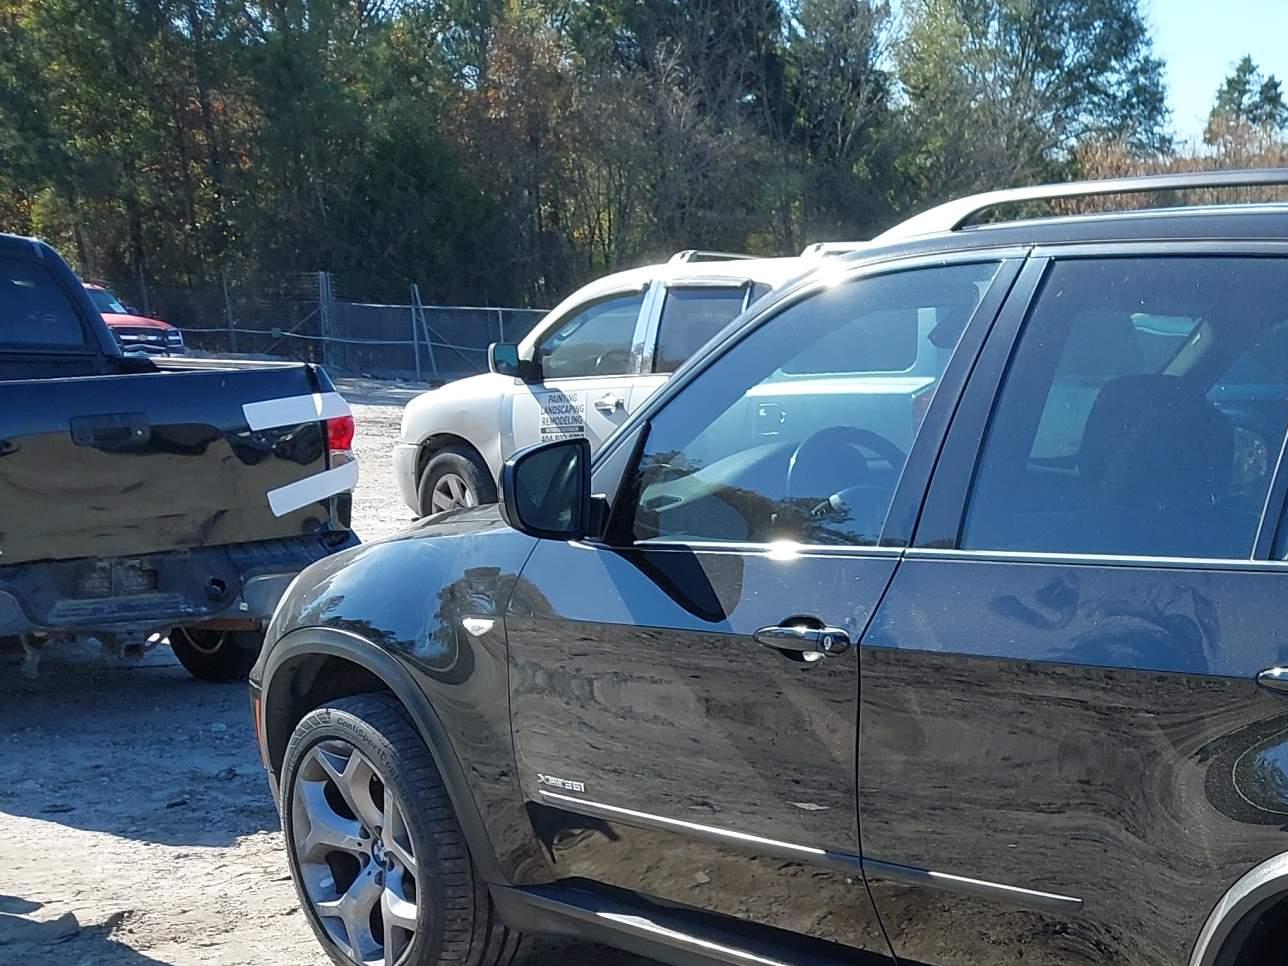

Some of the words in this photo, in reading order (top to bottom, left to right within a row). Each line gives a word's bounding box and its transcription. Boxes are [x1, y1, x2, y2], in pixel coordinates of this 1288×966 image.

[548, 393, 578, 404] PAINTING
[540, 403, 585, 416] LANDSCAPING
[541, 415, 583, 426] REMODELING
